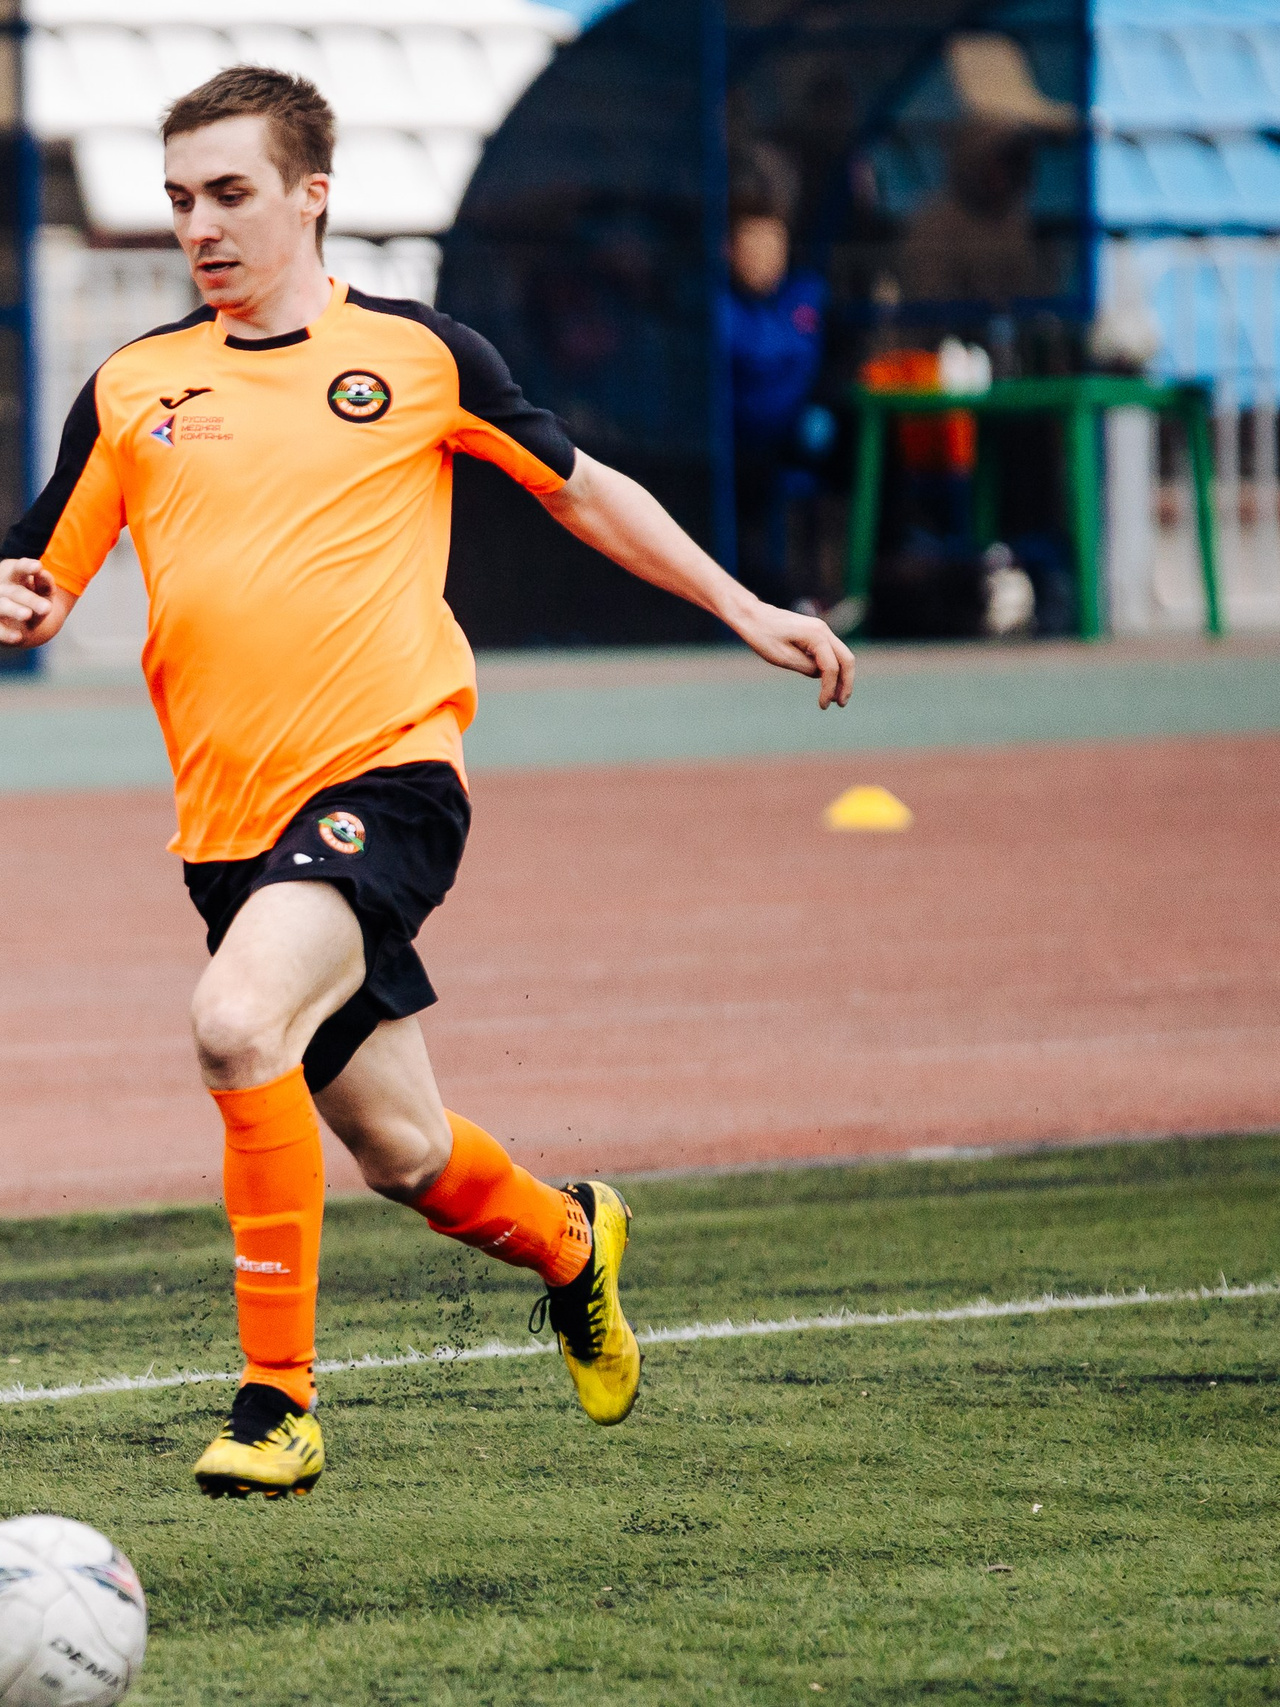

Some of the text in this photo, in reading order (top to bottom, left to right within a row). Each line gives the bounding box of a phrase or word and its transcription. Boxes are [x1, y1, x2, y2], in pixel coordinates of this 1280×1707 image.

[182, 415, 224, 423] РУССКАЯ
[180, 432, 234, 440] КОМПАНИЯ
[234, 1255, 291, 1275] ÖGEL
